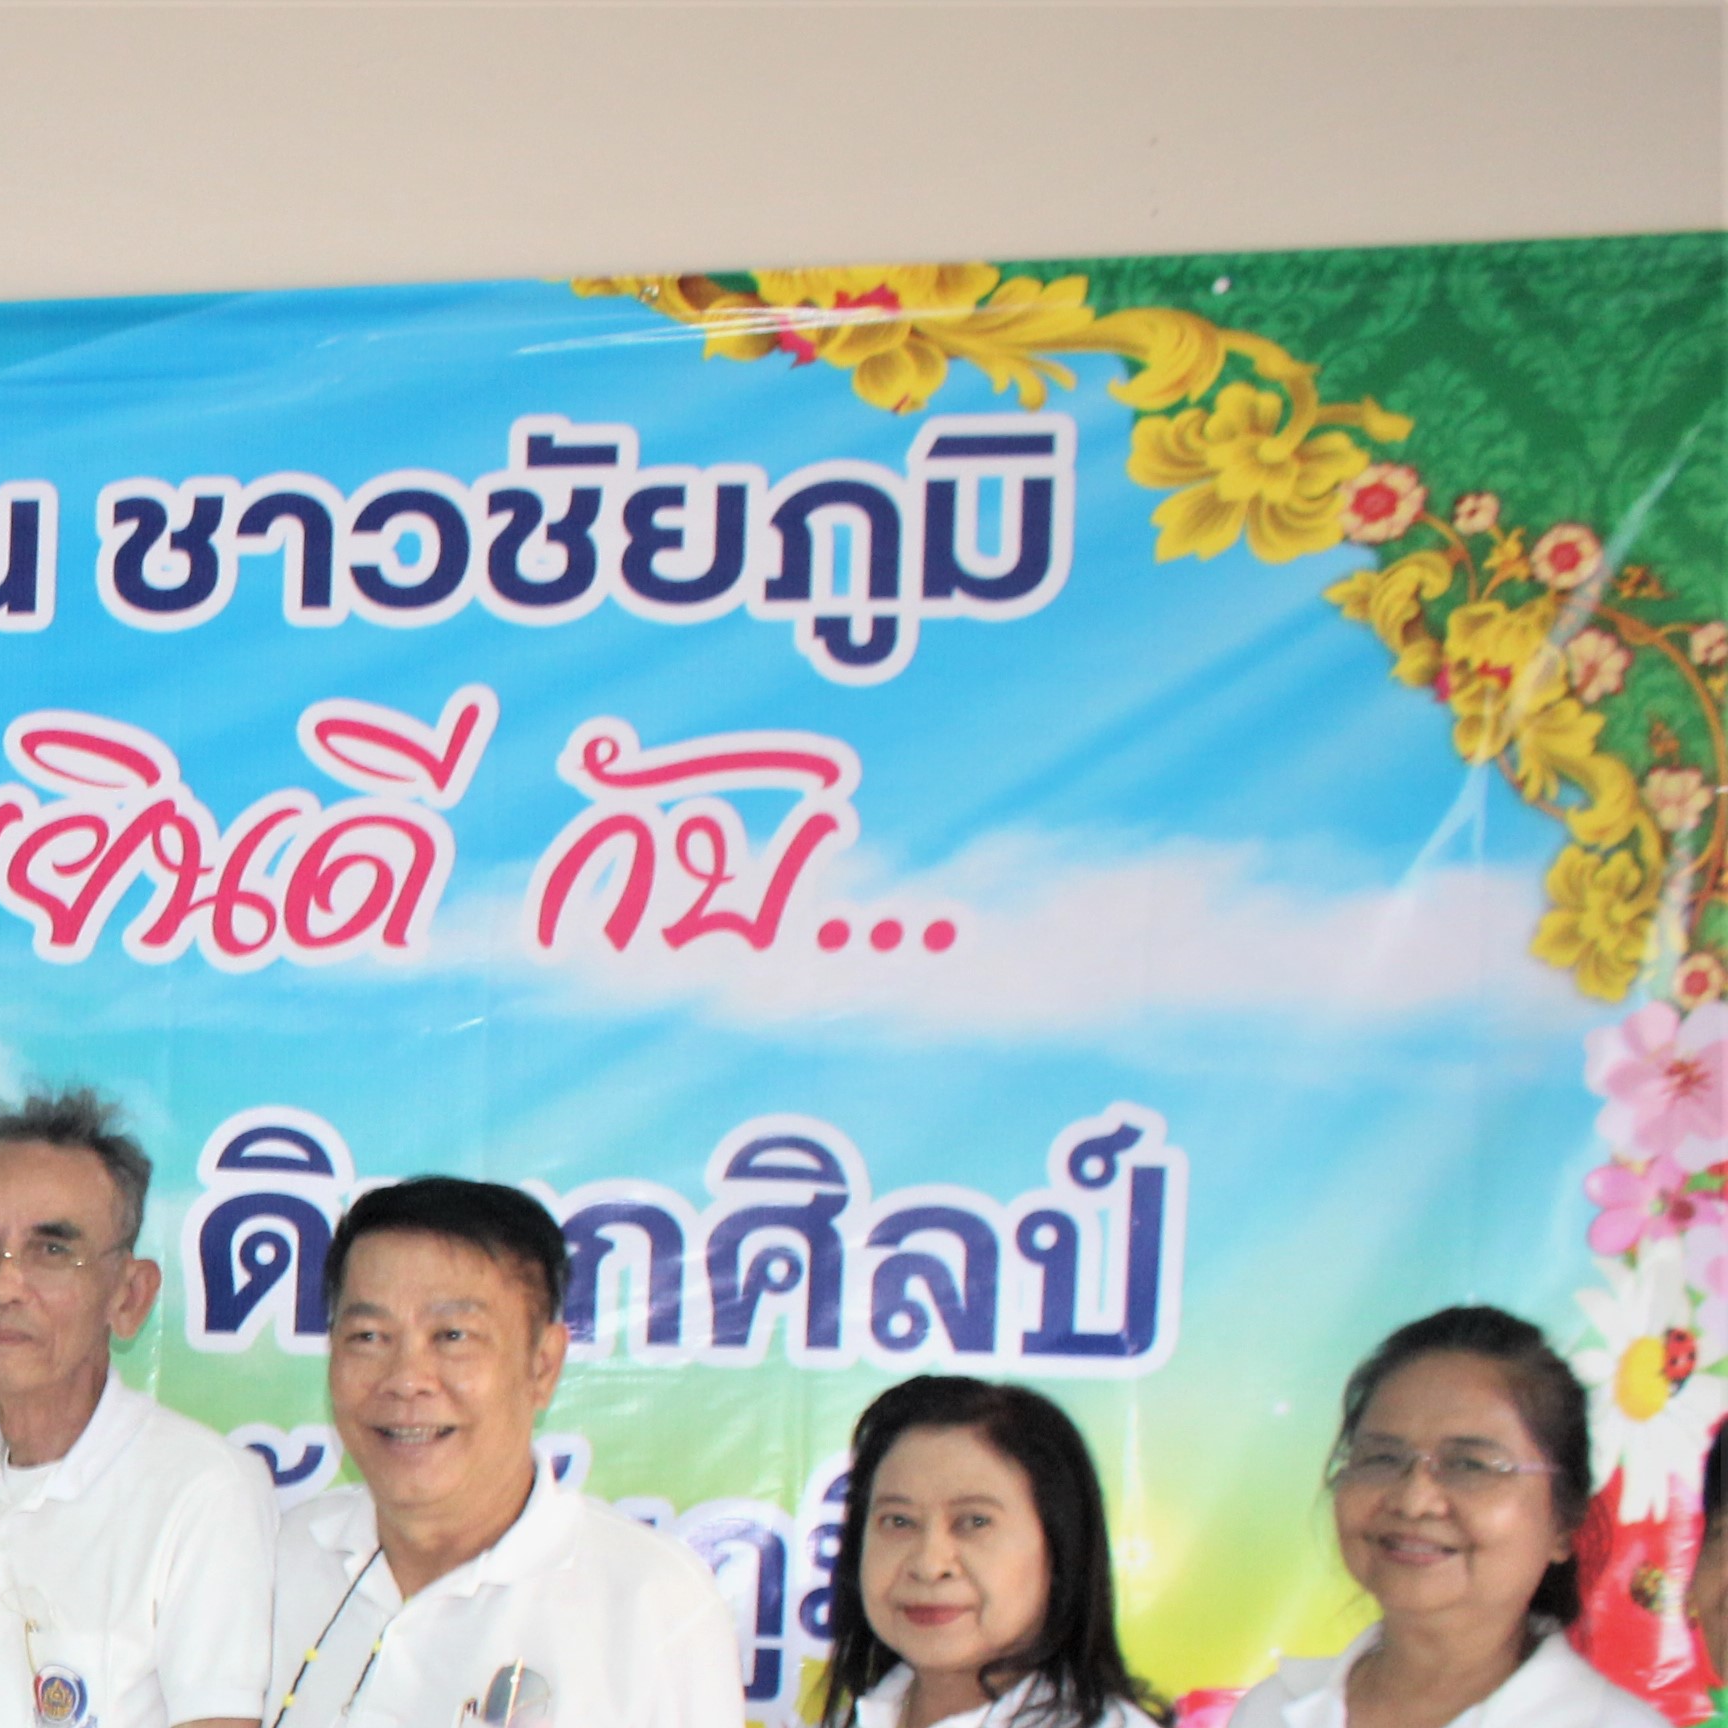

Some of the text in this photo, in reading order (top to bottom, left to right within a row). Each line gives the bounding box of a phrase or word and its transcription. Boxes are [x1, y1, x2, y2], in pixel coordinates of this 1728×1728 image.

[111, 432, 1056, 668] ชาวชัยภูมิ
[536, 736, 957, 953] กับ...
[198, 1123, 1166, 1358] ดิกศิลป์
